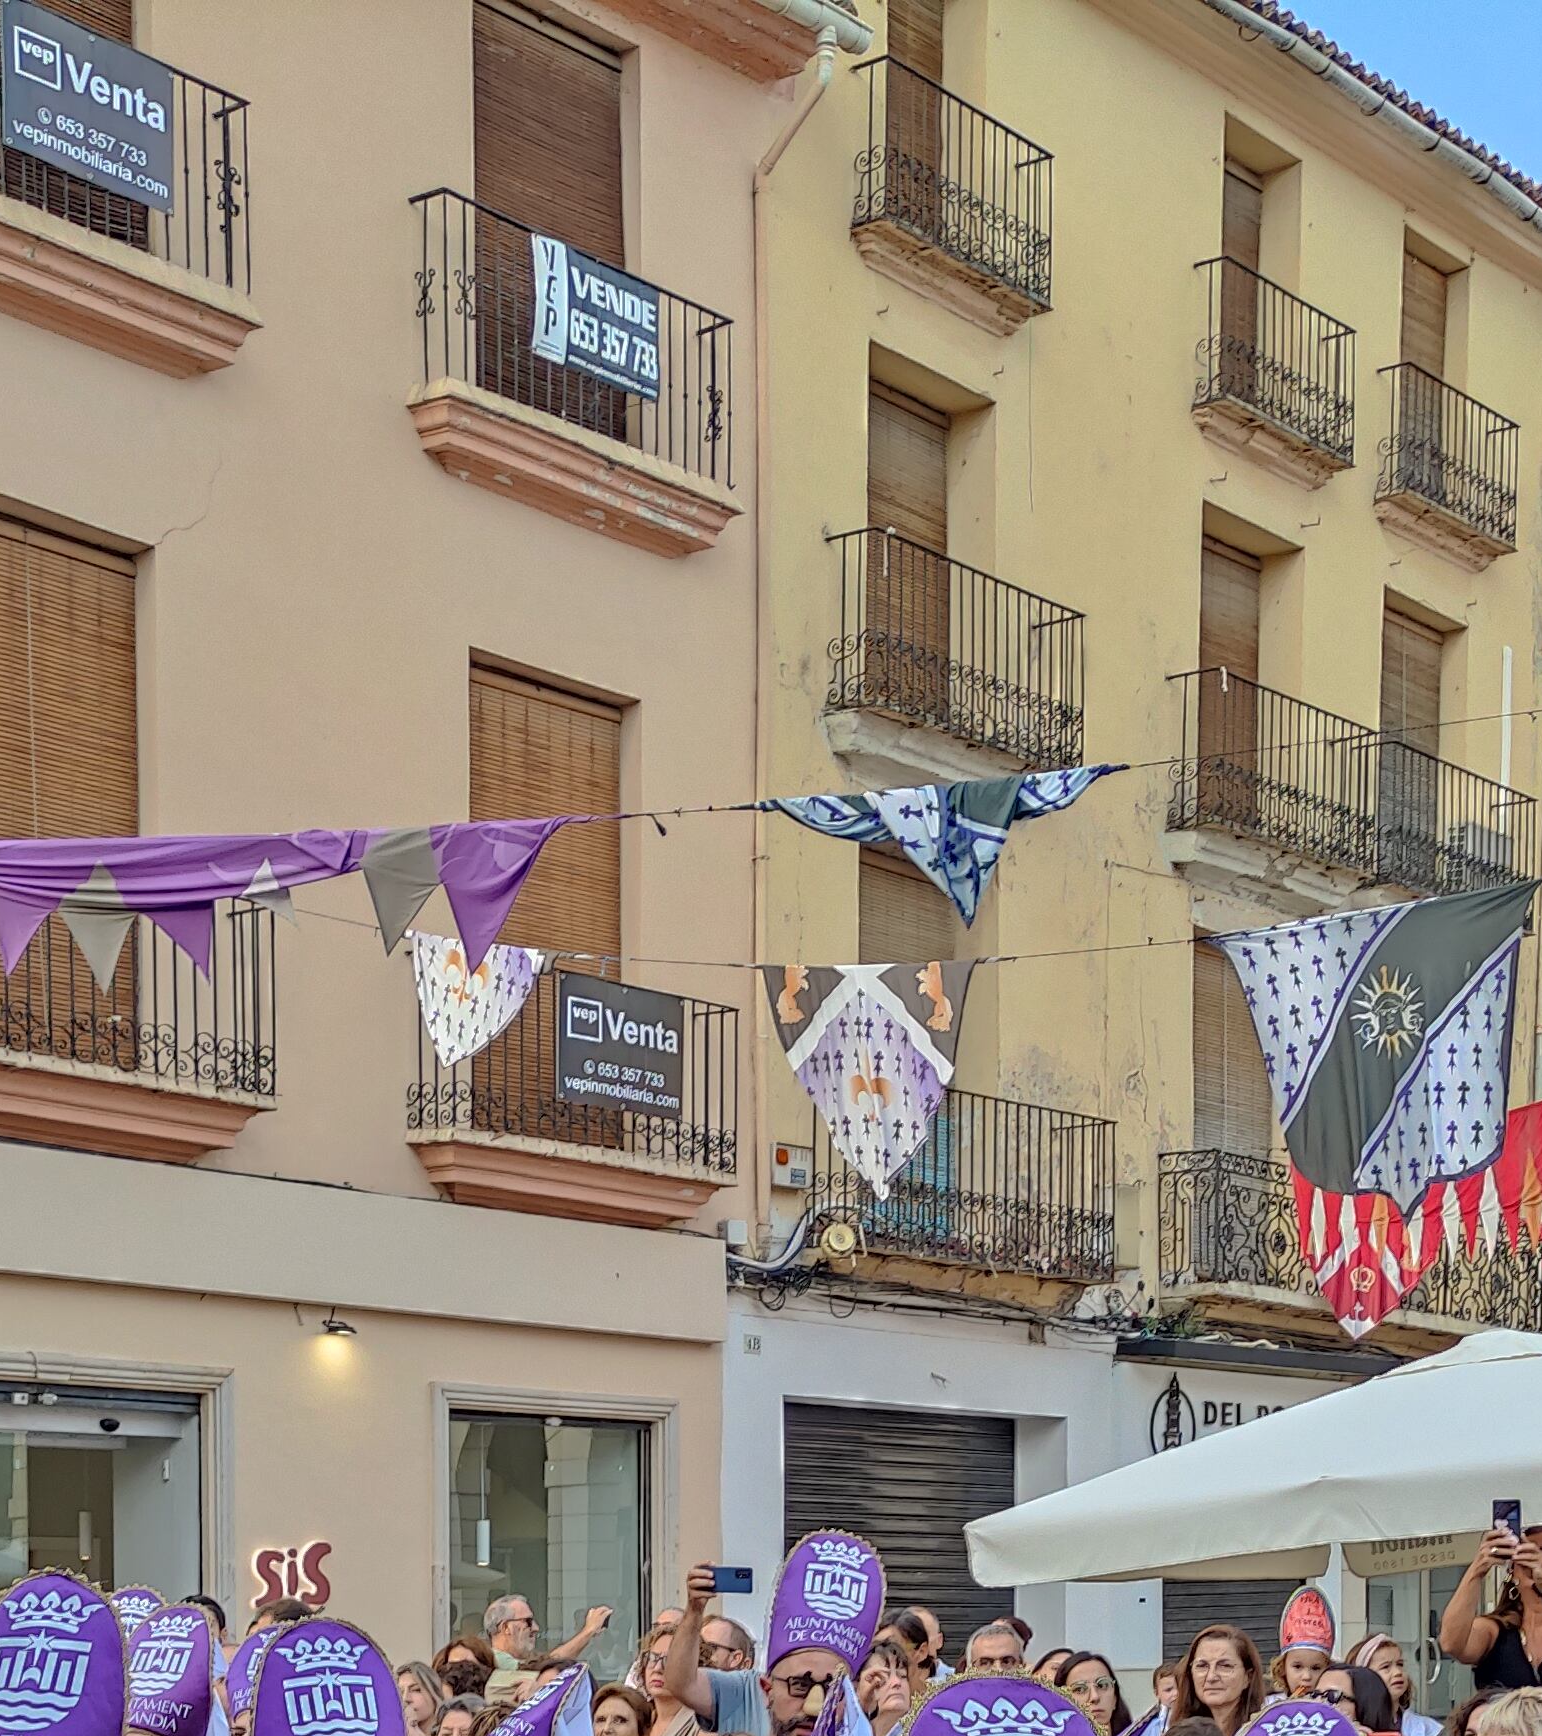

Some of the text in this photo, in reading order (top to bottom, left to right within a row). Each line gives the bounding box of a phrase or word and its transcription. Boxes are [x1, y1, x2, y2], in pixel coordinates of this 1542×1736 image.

[21, 39, 55, 65] vep
[64, 52, 166, 133] Venta
[12, 119, 169, 199] vepinmobiliaria.com
[56, 114, 148, 167] 653 357 733
[540, 240, 558, 336] VEP
[570, 266, 657, 332] VENDE
[570, 308, 658, 381] 653 357 733
[573, 1005, 598, 1024] vep
[605, 1008, 678, 1054] Venta
[597, 1061, 619, 1079] 653
[620, 1066, 642, 1083] 357
[1203, 1400, 1244, 1427] DEL
[788, 1630, 805, 1643] DE
